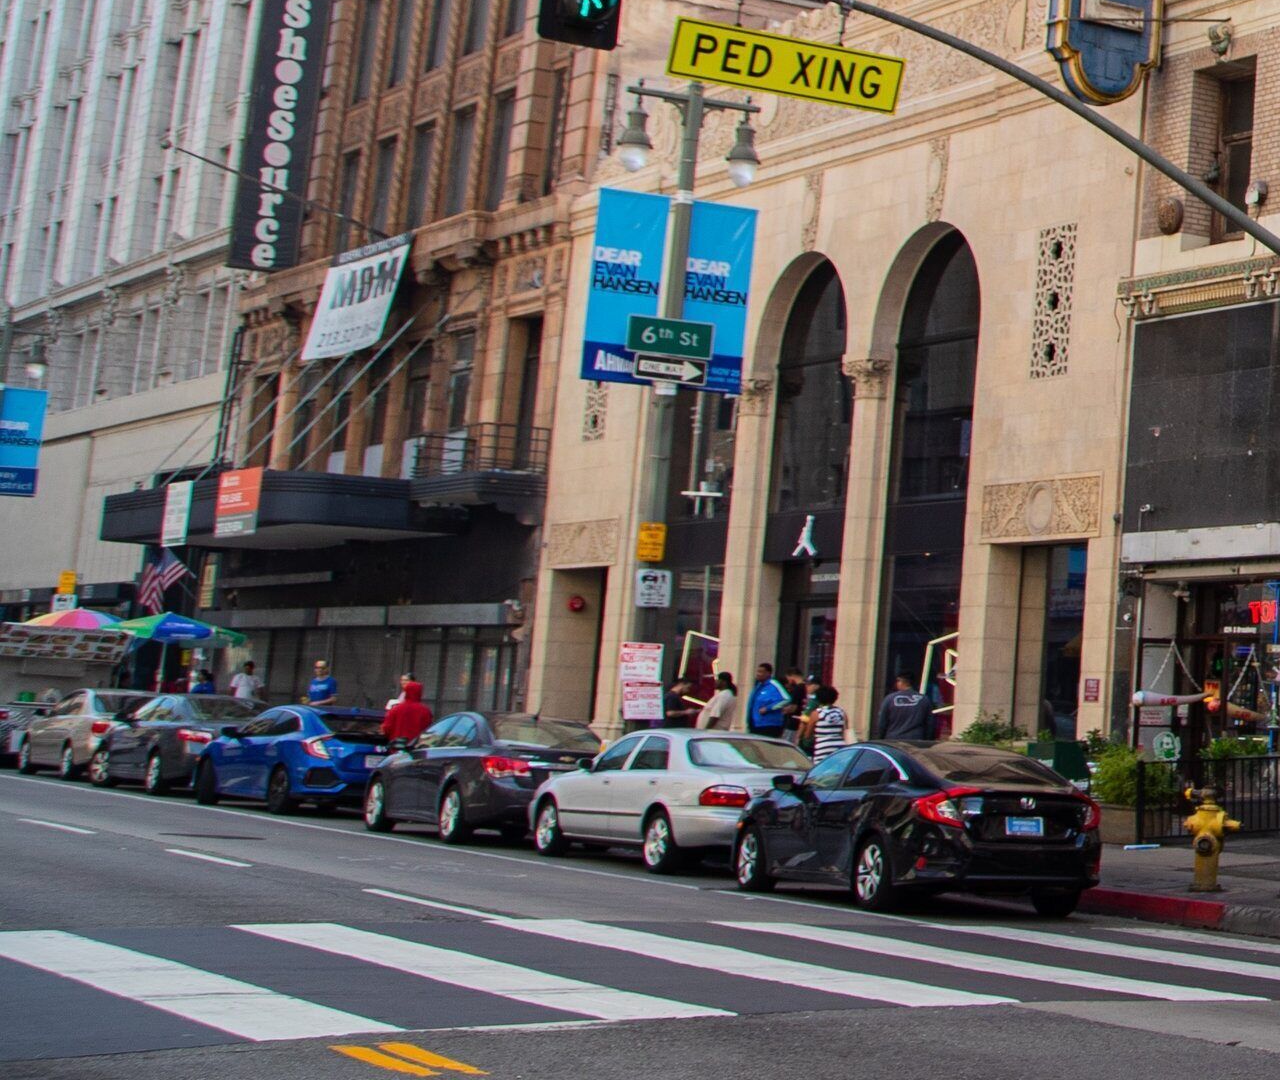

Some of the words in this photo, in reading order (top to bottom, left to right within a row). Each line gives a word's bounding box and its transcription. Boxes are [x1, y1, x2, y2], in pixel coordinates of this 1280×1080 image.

[690, 33, 773, 79] PED
[790, 51, 884, 100] XING
[594, 246, 643, 267] DEAR
[594, 260, 637, 279] EVAN
[686, 257, 731, 278] DEAR
[592, 274, 659, 296] HANSEN
[685, 271, 727, 289] EVAN
[683, 284, 748, 306] HANSEN
[641, 325, 674, 344] 6th
[679, 331, 699, 348] St
[642, 361, 661, 371] ONE
